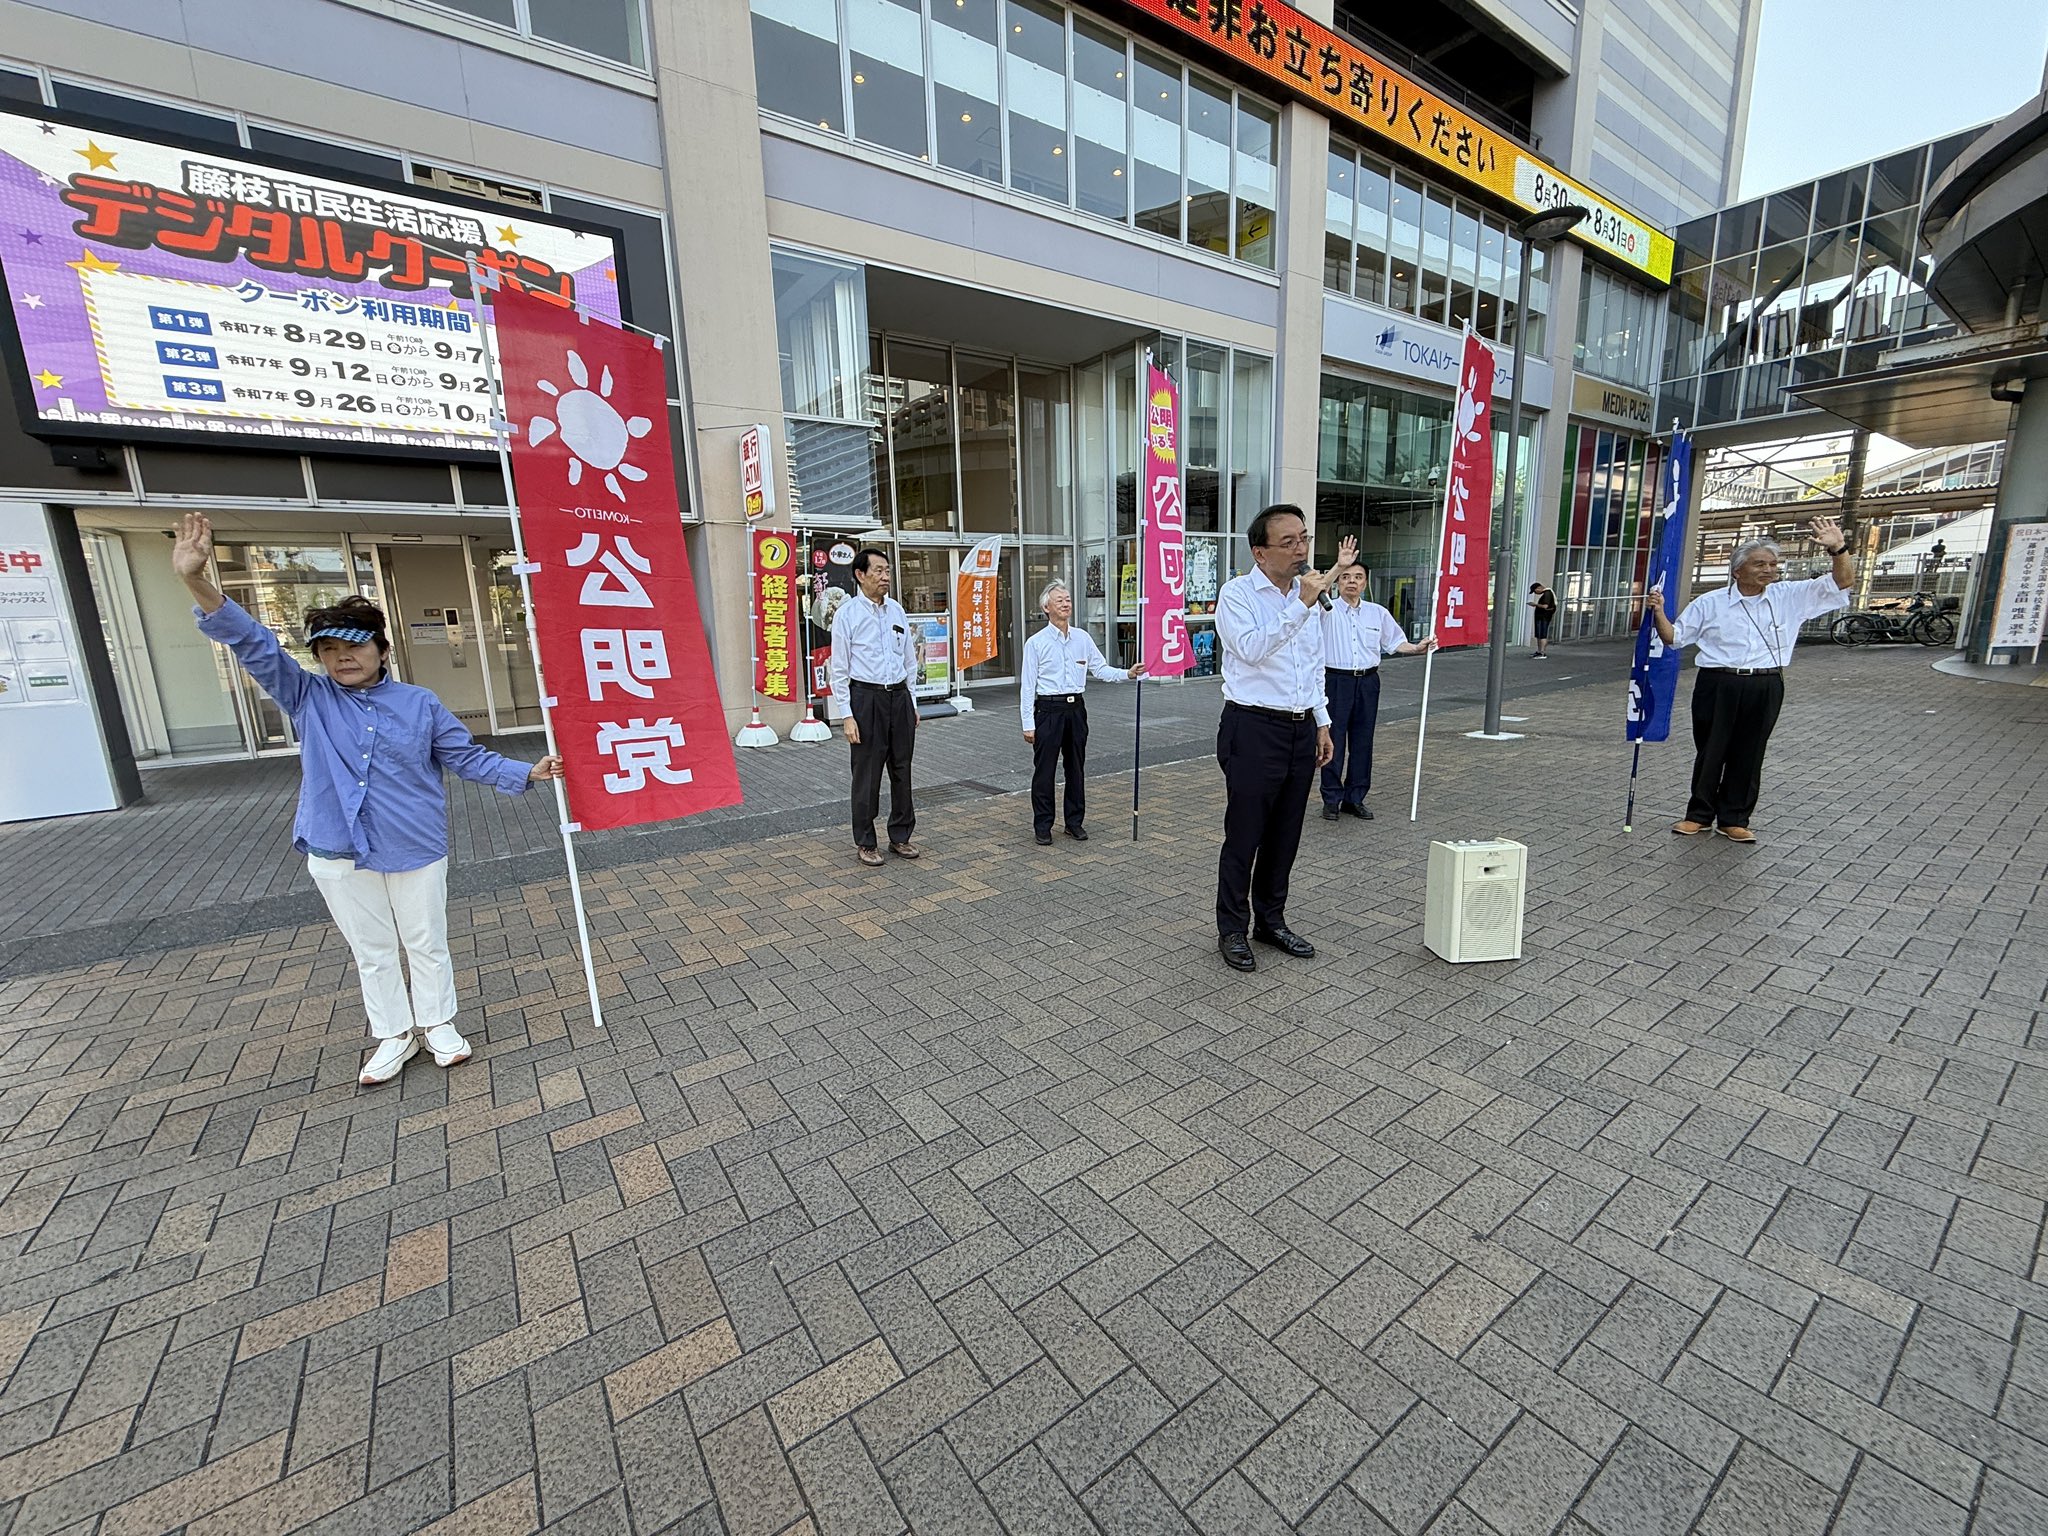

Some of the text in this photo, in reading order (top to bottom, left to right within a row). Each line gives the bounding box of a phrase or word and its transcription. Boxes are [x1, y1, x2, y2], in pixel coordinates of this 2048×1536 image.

[186, 164, 484, 246] 藤枝市民生活応援
[66, 176, 573, 308] デジタルクーポン
[157, 312, 205, 329] 第1弾
[237, 282, 472, 333] クーポン利用期間
[164, 346, 212, 363] 第2弾
[171, 380, 219, 396] 第3弾
[1601, 390, 1651, 423] MEDIA PLAZA
[743, 436, 757, 461] 銀行
[745, 461, 760, 487] ATM
[830, 550, 854, 559] 中華まん
[972, 580, 983, 638] 見学・体験
[760, 574, 790, 697] 経営者募集
